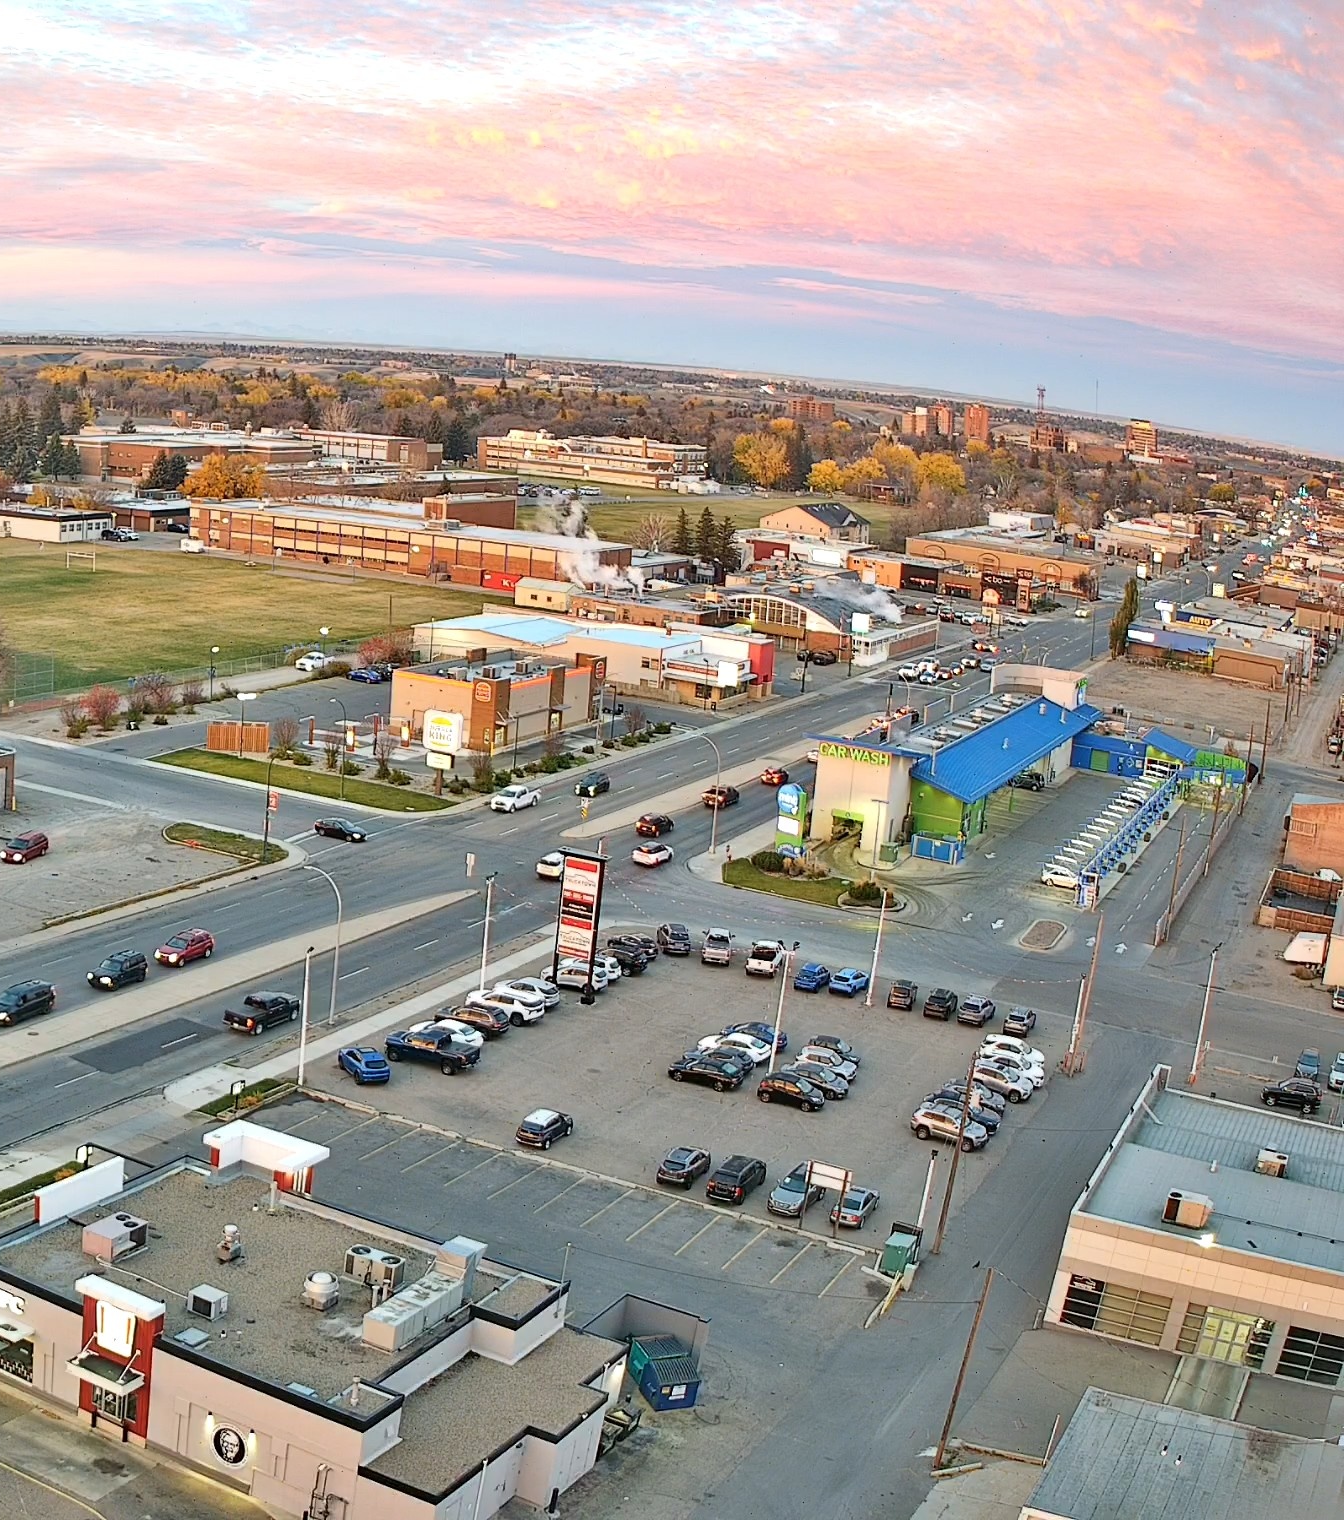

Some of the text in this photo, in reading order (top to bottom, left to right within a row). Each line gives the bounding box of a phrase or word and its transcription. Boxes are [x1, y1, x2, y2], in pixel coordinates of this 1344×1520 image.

[1189, 616, 1211, 626] AUTO
[429, 731, 452, 742] KING
[820, 743, 891, 766] CAR WASH
